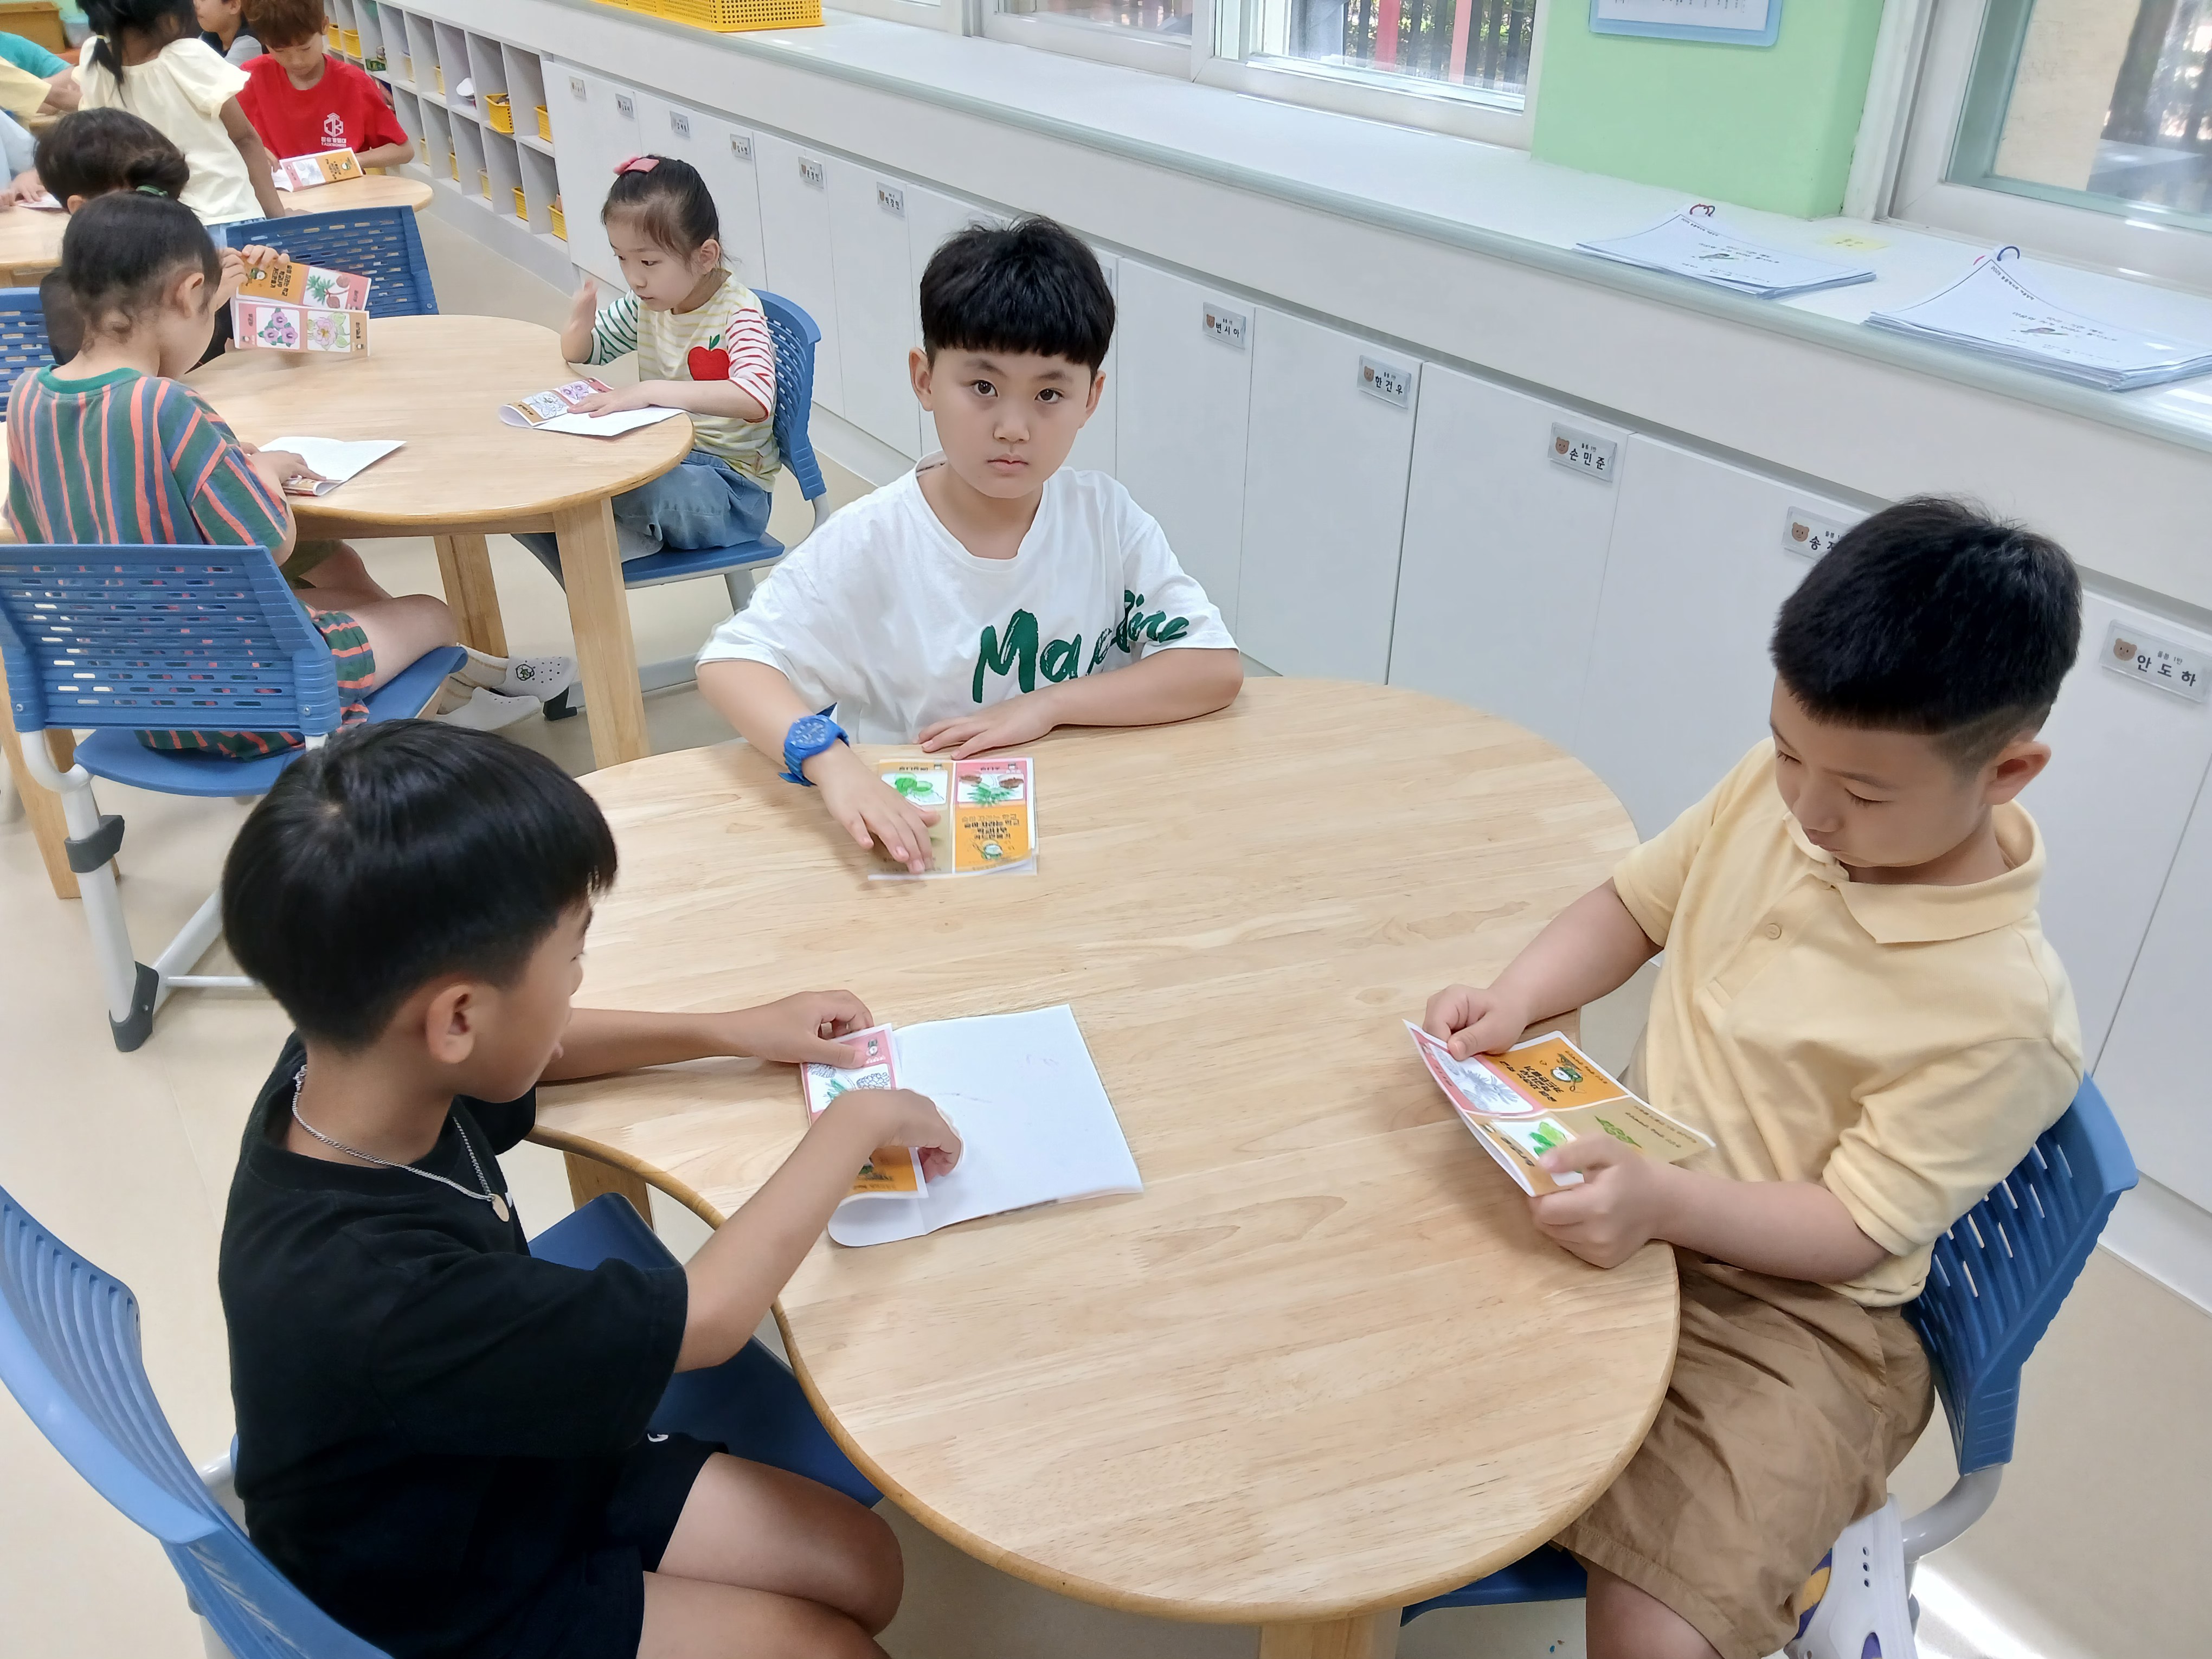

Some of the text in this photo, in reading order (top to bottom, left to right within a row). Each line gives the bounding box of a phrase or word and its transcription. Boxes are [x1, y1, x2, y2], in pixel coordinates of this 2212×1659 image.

[1216, 323, 1239, 338] 변시아
[1375, 376, 1403, 395] 한건우
[1569, 448, 1605, 470] 손민준
[2137, 654, 2196, 687] 안도하
